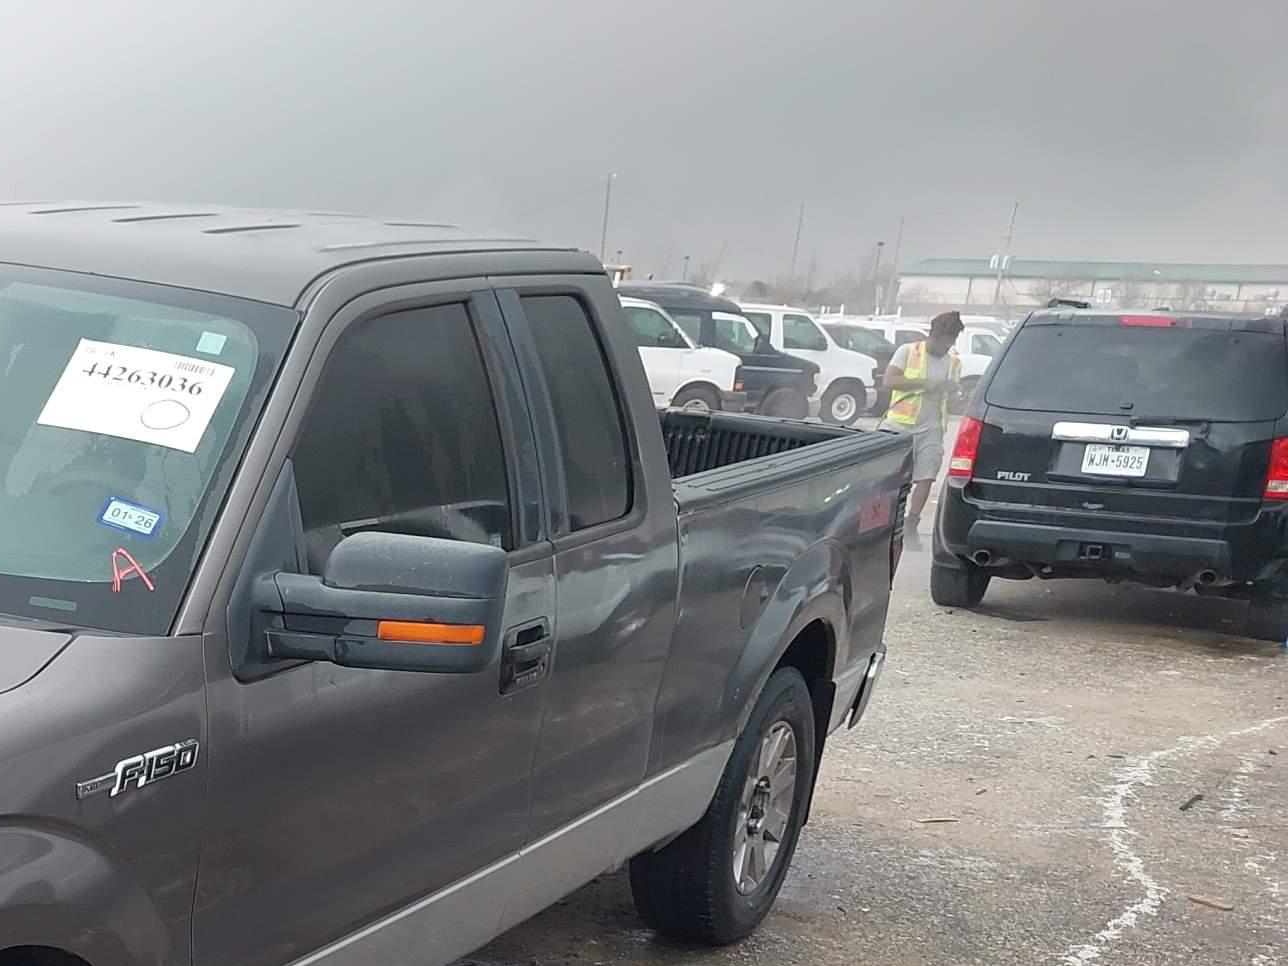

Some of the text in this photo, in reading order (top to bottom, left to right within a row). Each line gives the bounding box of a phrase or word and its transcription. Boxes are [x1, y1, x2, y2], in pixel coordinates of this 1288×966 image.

[83, 362, 205, 396] 44263036
[996, 470, 1032, 481] PILOT
[111, 507, 154, 528] 01 26
[112, 547, 155, 593] A
